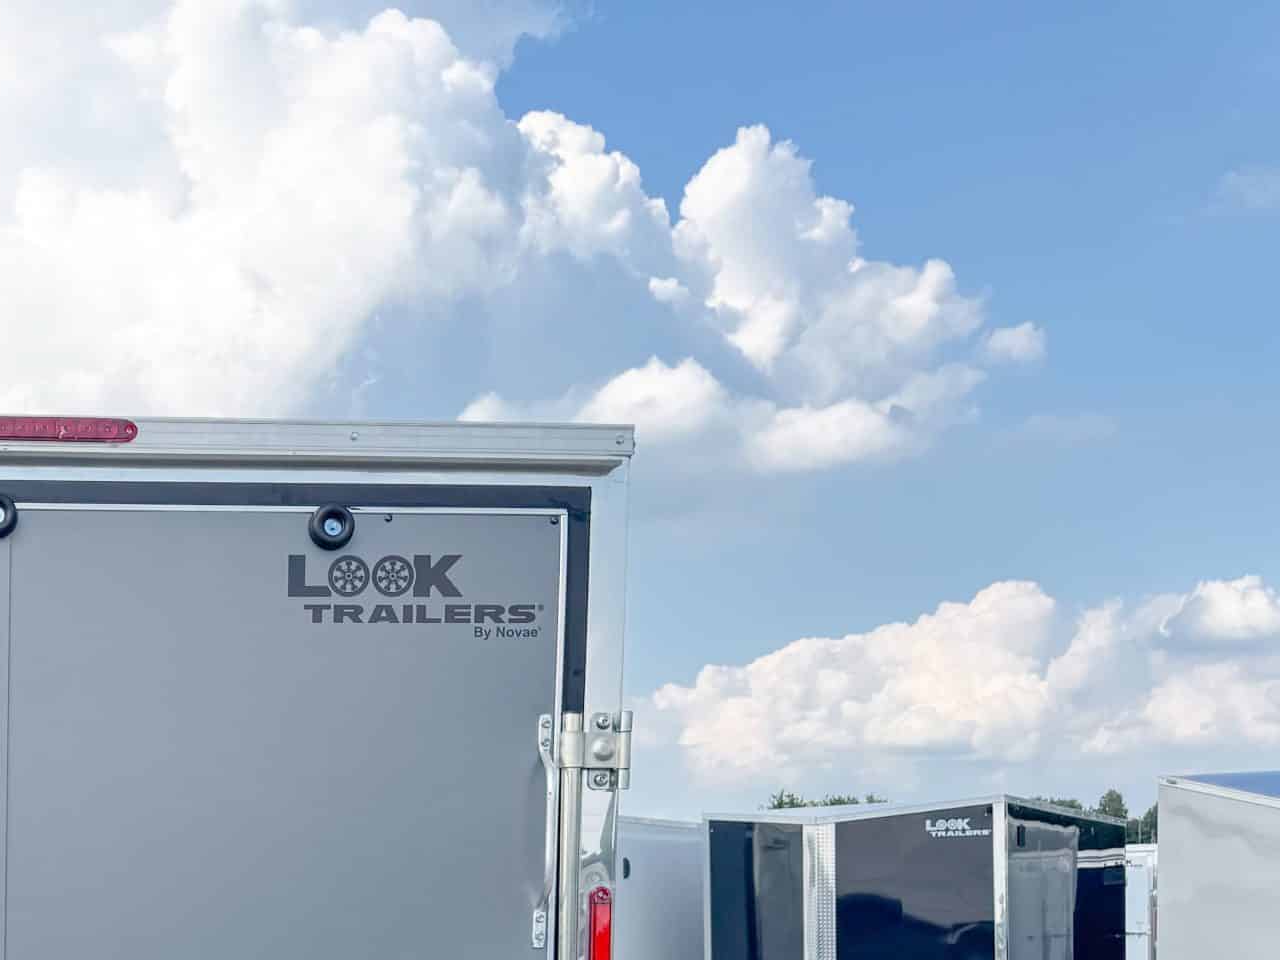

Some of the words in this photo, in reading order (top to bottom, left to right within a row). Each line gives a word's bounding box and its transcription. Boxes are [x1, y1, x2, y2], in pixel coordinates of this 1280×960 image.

[287, 554, 463, 597] LOOK
[303, 604, 537, 623] TRAILERS
[474, 626, 491, 640] By
[496, 626, 538, 638] Novae
[925, 817, 971, 831] LOOK
